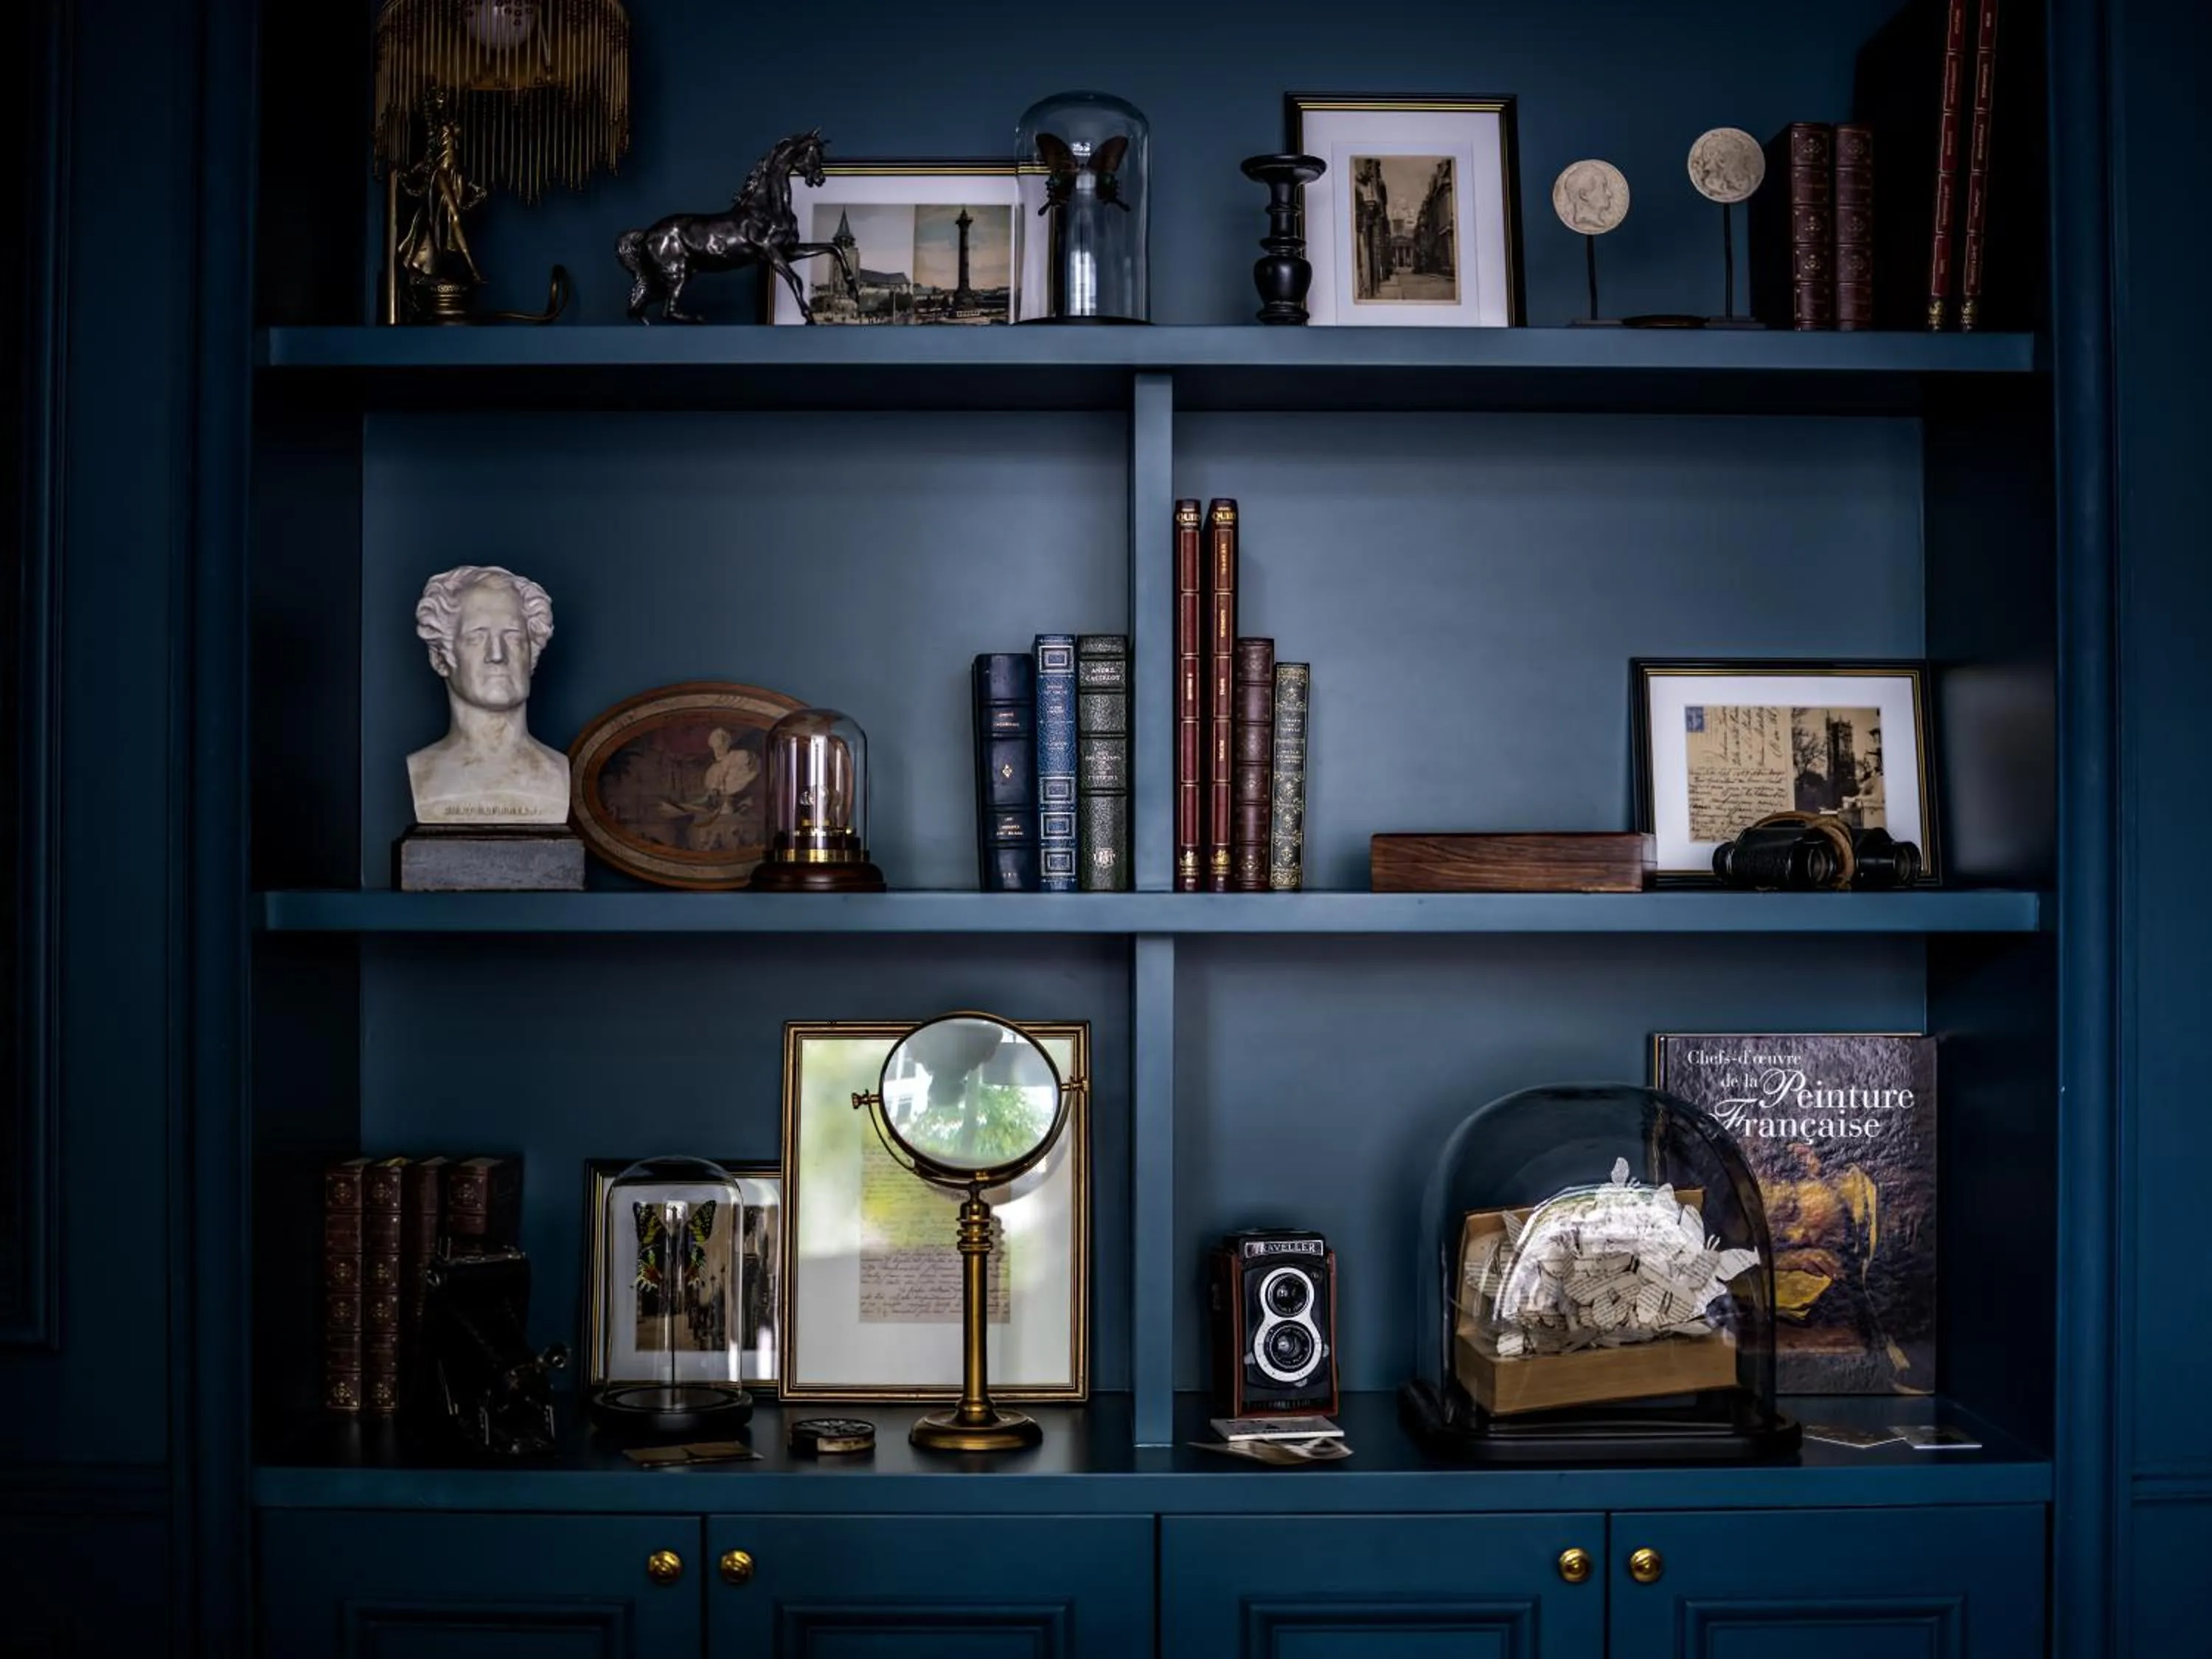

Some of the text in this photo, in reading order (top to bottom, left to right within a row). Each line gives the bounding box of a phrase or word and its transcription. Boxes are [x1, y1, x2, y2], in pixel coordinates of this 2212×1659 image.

[1720, 1073, 1758, 1088] de la
[1759, 1068, 1915, 1109] Peinture
[1708, 1098, 1881, 1145] Française
